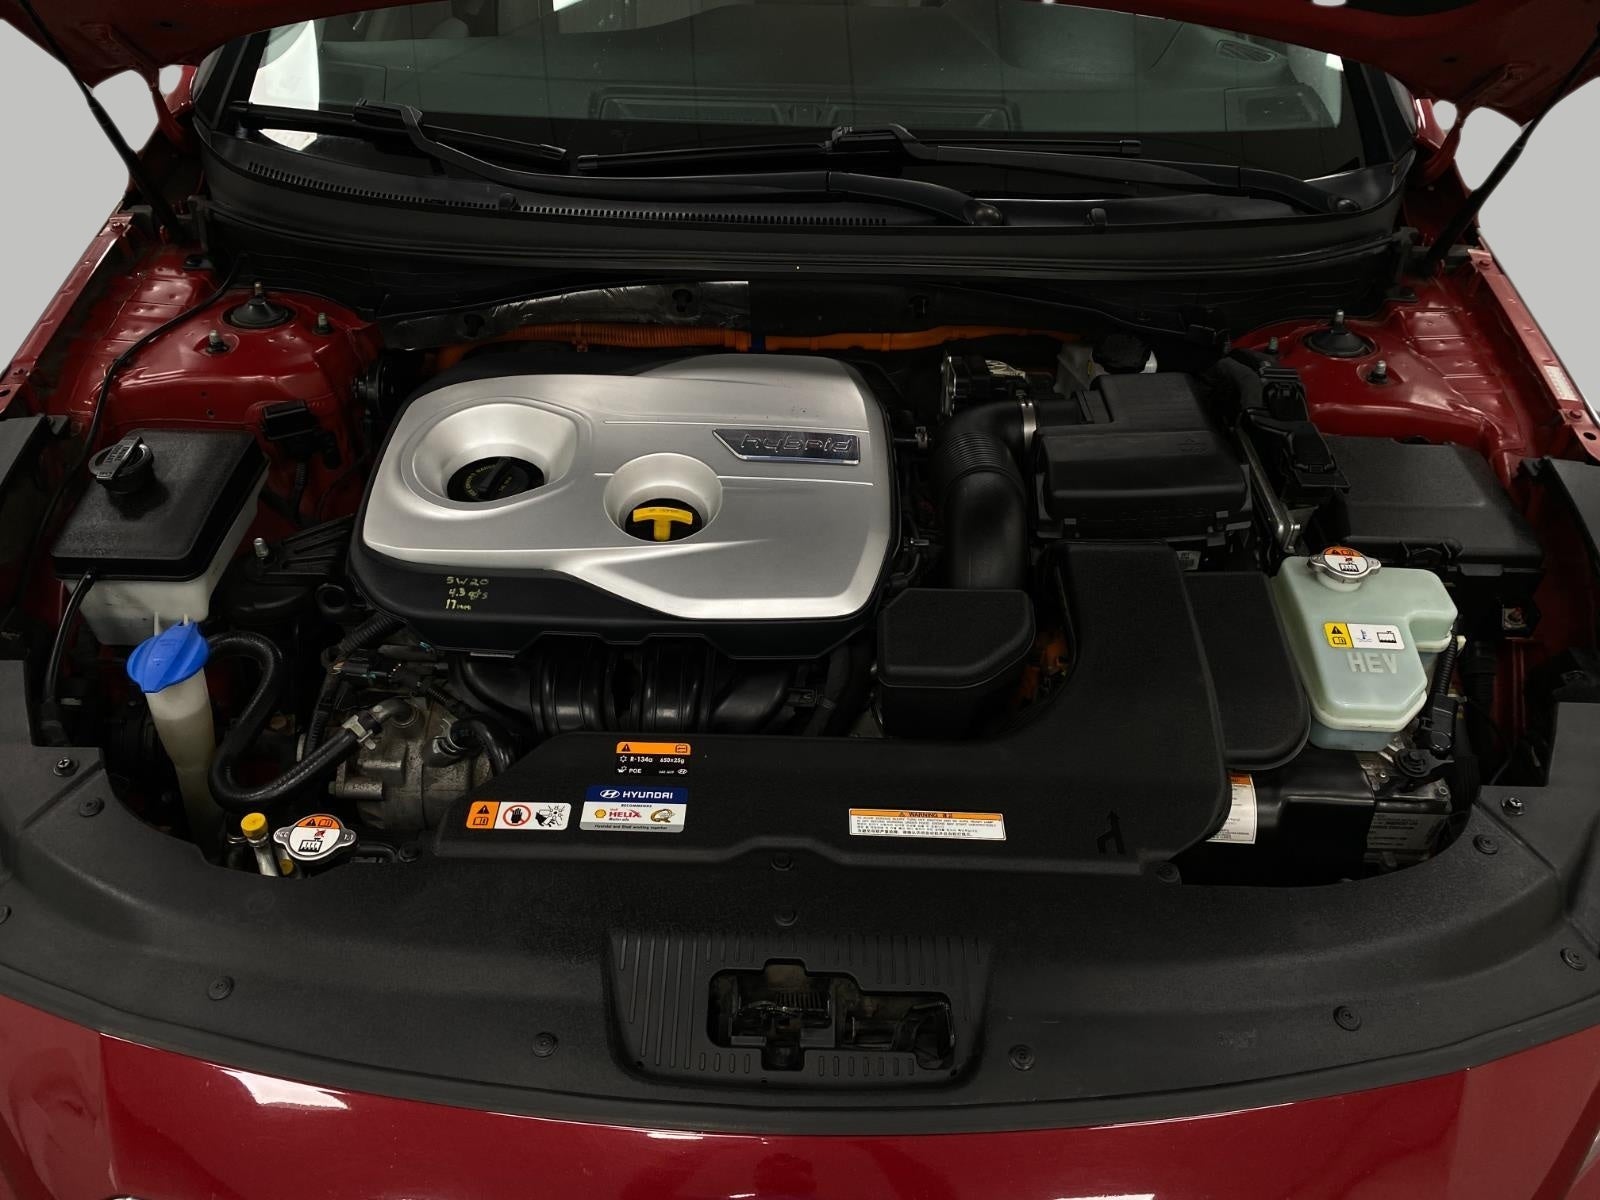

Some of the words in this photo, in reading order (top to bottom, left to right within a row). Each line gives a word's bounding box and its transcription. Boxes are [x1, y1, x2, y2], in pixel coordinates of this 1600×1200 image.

[741, 434, 853, 453] hybrid
[448, 587, 466, 598] 4.3
[1346, 651, 1400, 674] HEV
[622, 791, 674, 800] HYUNDAI
[608, 809, 642, 818] HELIX
